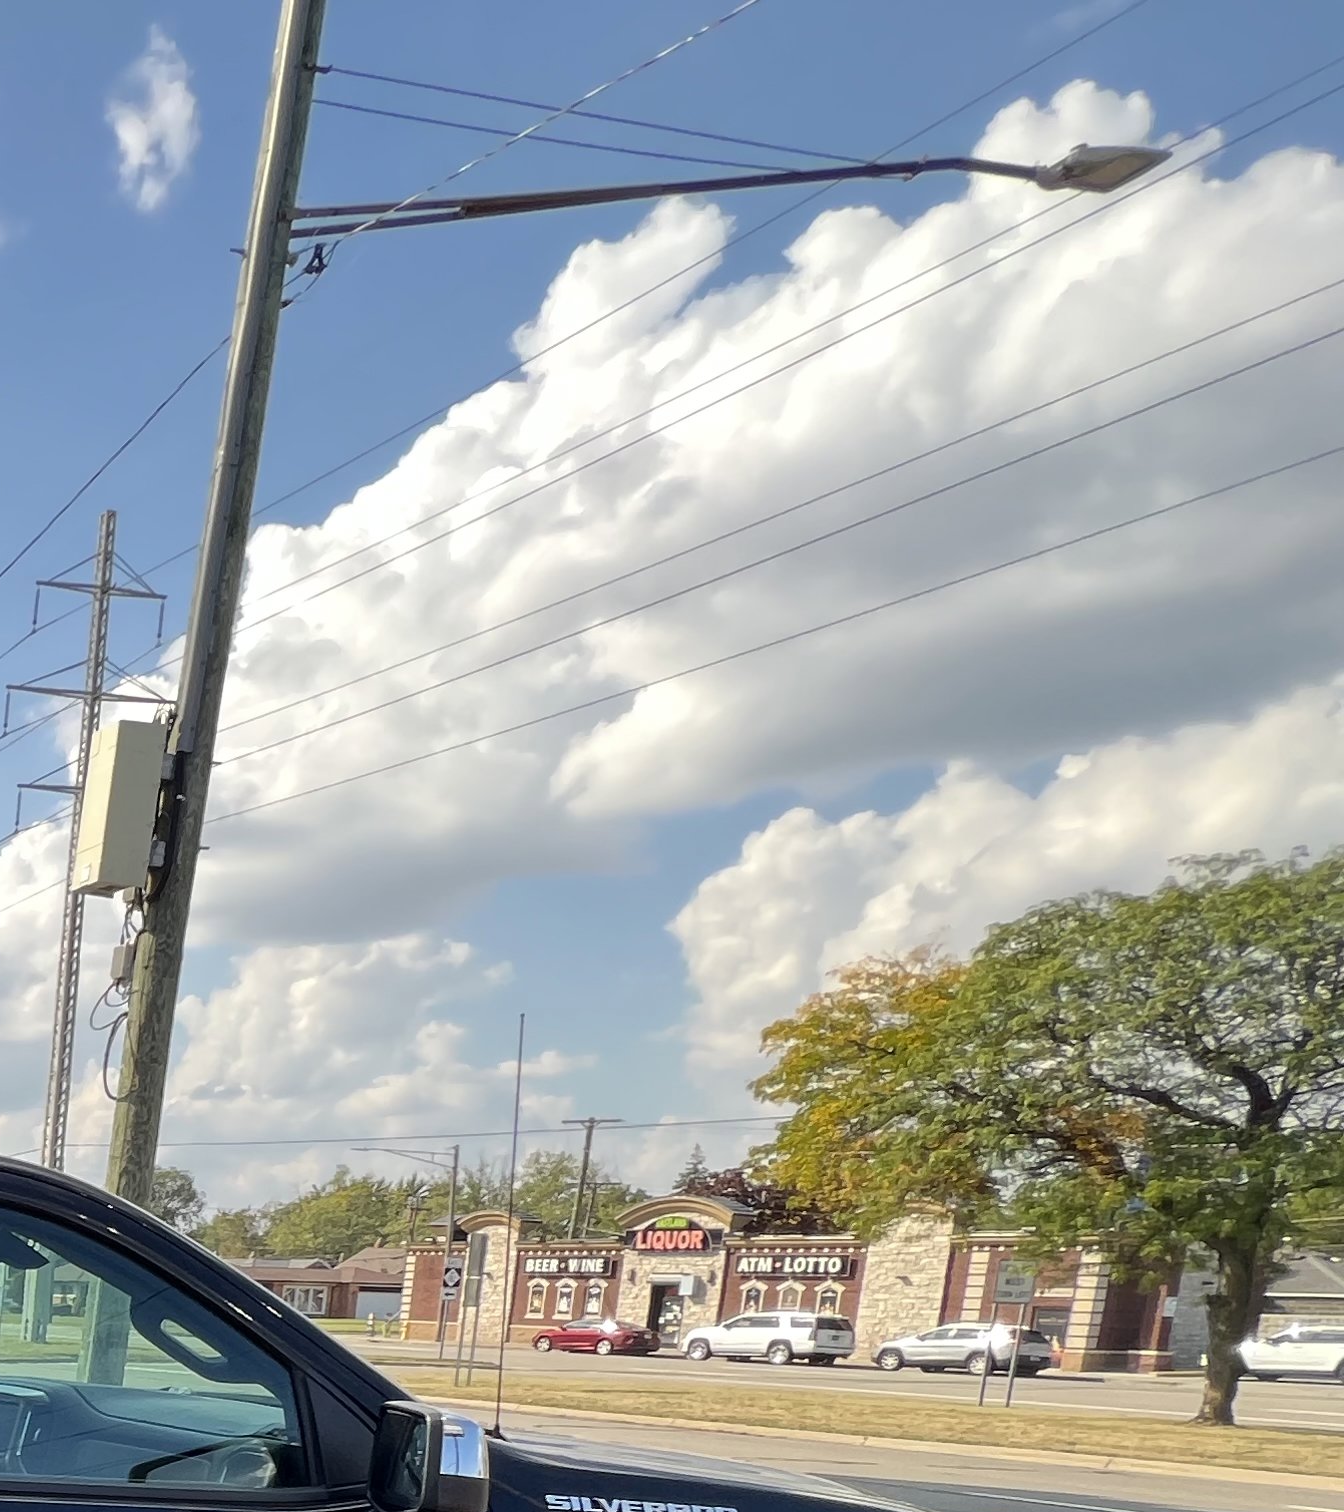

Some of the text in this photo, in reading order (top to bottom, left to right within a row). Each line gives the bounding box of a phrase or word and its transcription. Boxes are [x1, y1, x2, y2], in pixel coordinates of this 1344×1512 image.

[635, 1229, 705, 1250] LIQUOR
[525, 1257, 605, 1273] BEER WINE
[737, 1255, 842, 1273] ATM LOTTO
